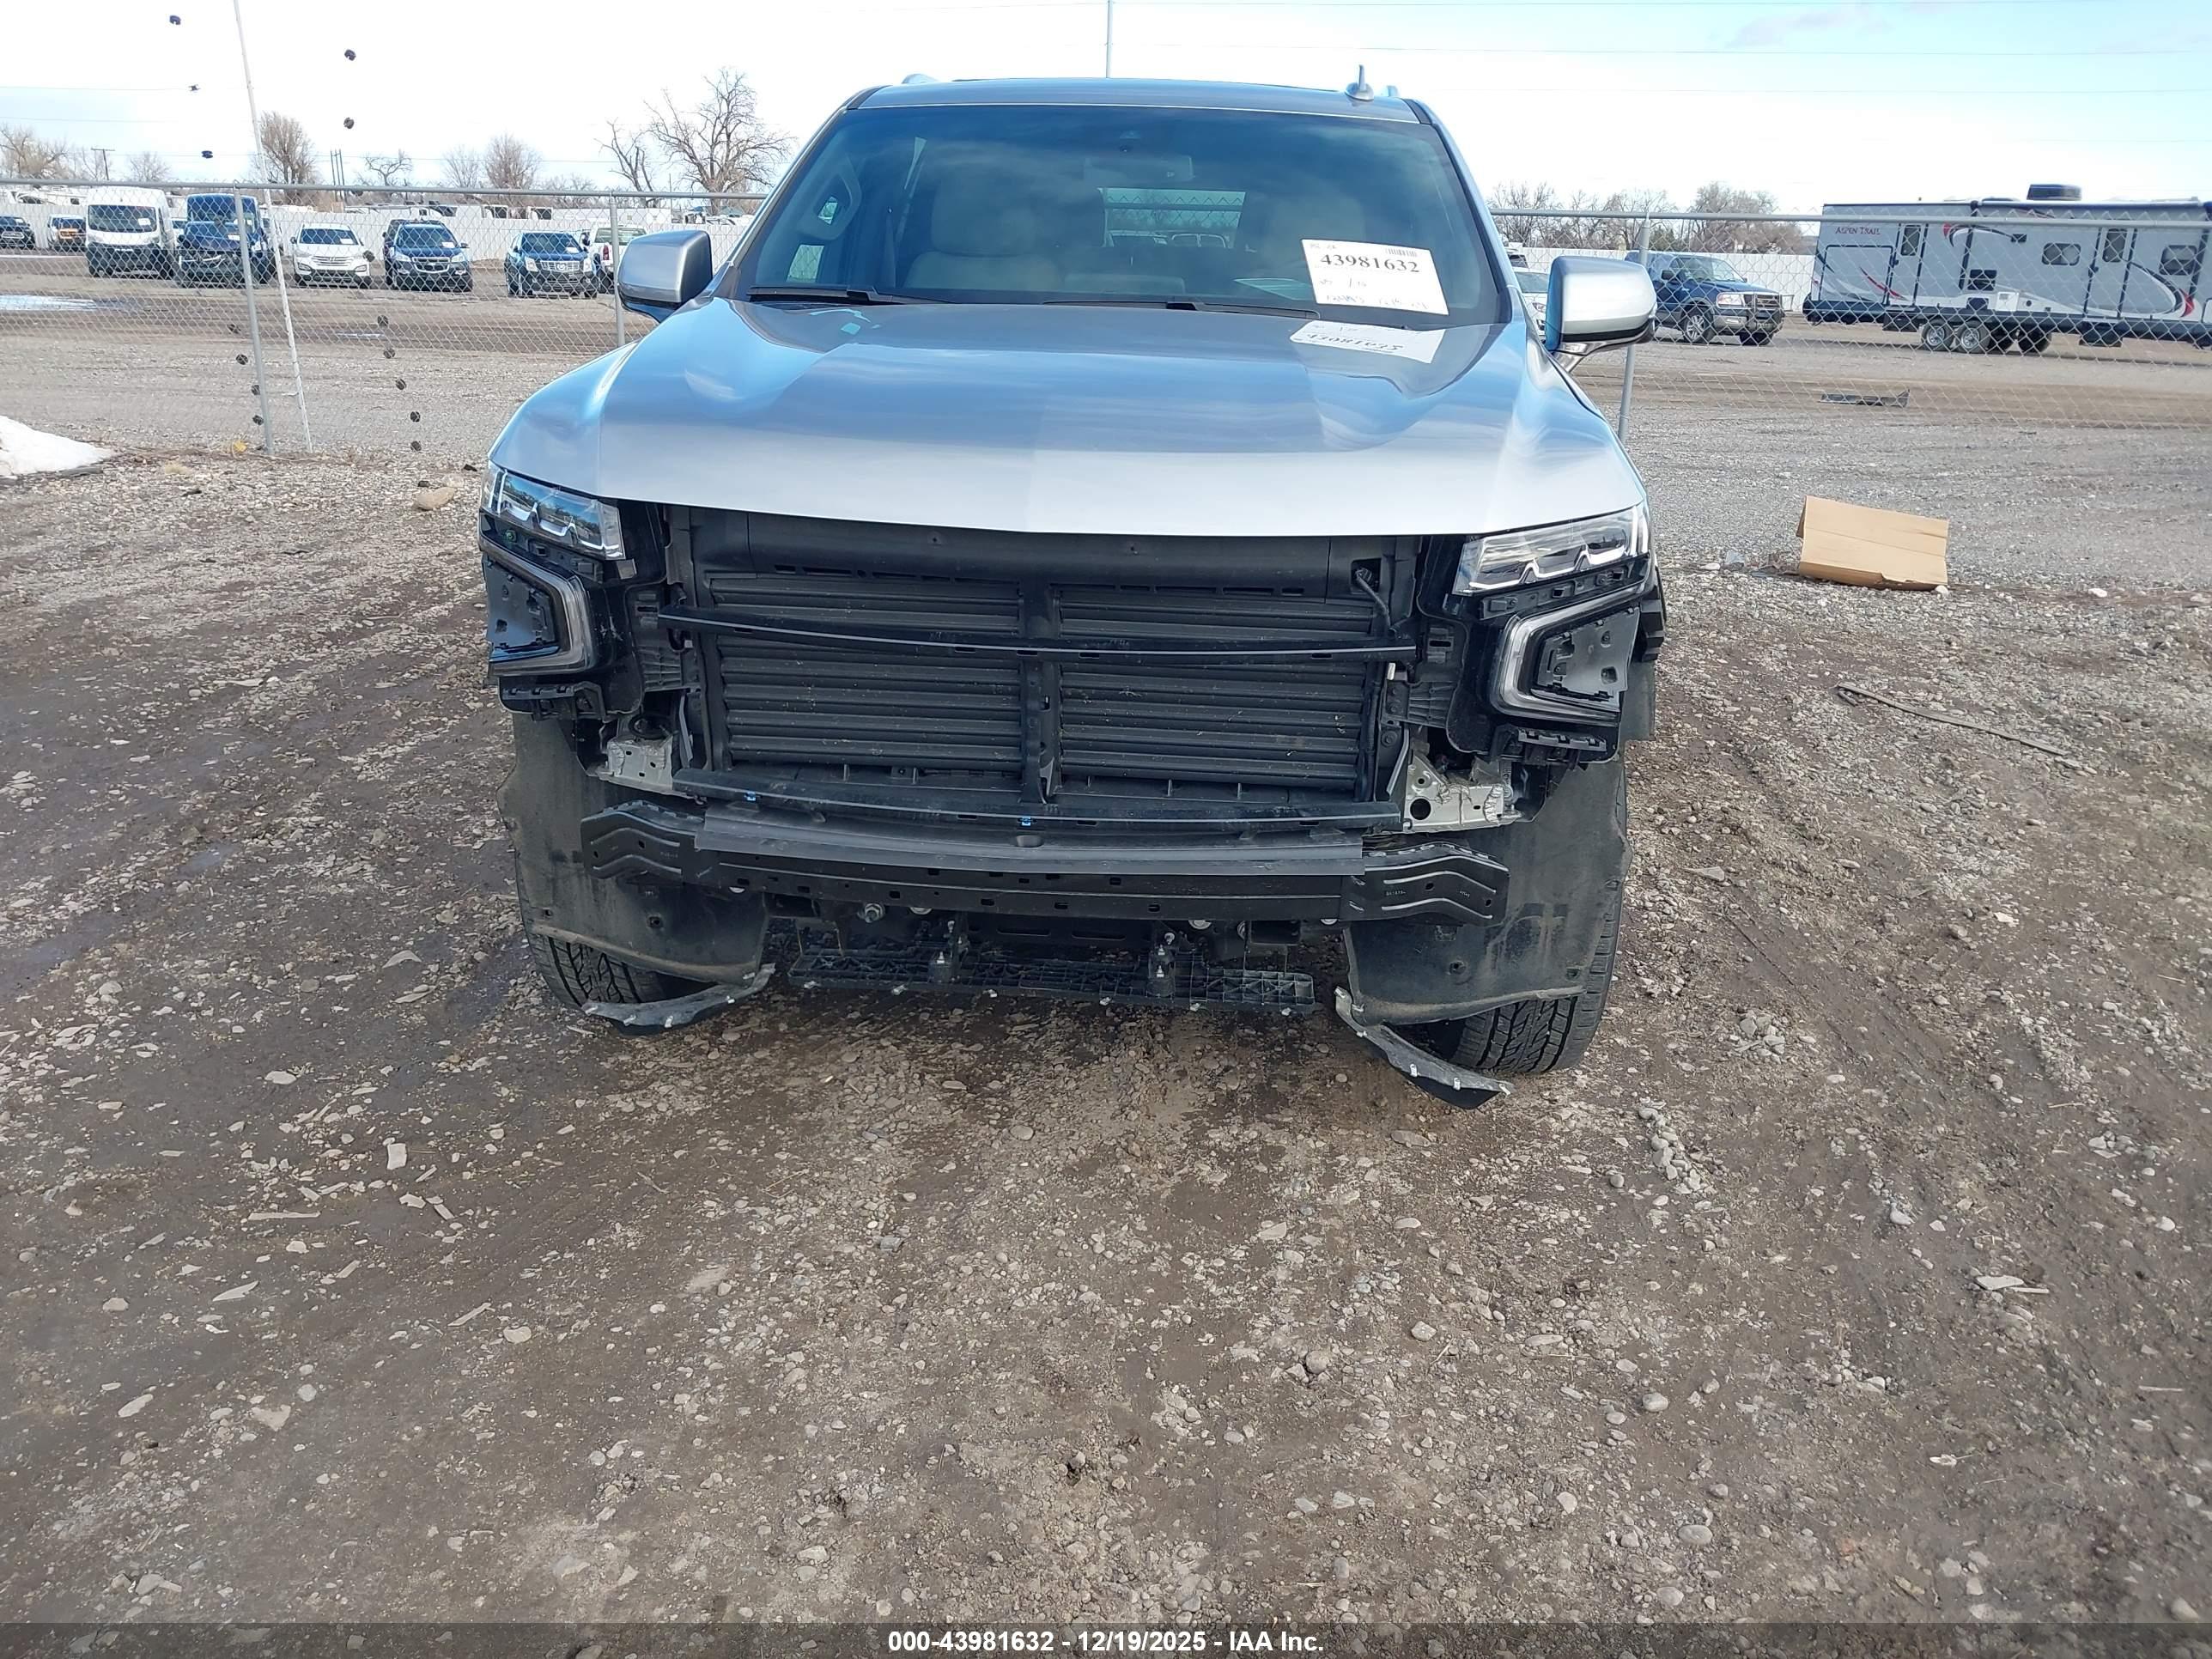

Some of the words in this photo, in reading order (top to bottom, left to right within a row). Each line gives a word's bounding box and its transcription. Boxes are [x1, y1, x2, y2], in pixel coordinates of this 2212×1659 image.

[1835, 226, 1858, 234] ASPEN
[1860, 226, 1881, 235] TRAIL
[1320, 253, 1420, 273] 43981632
